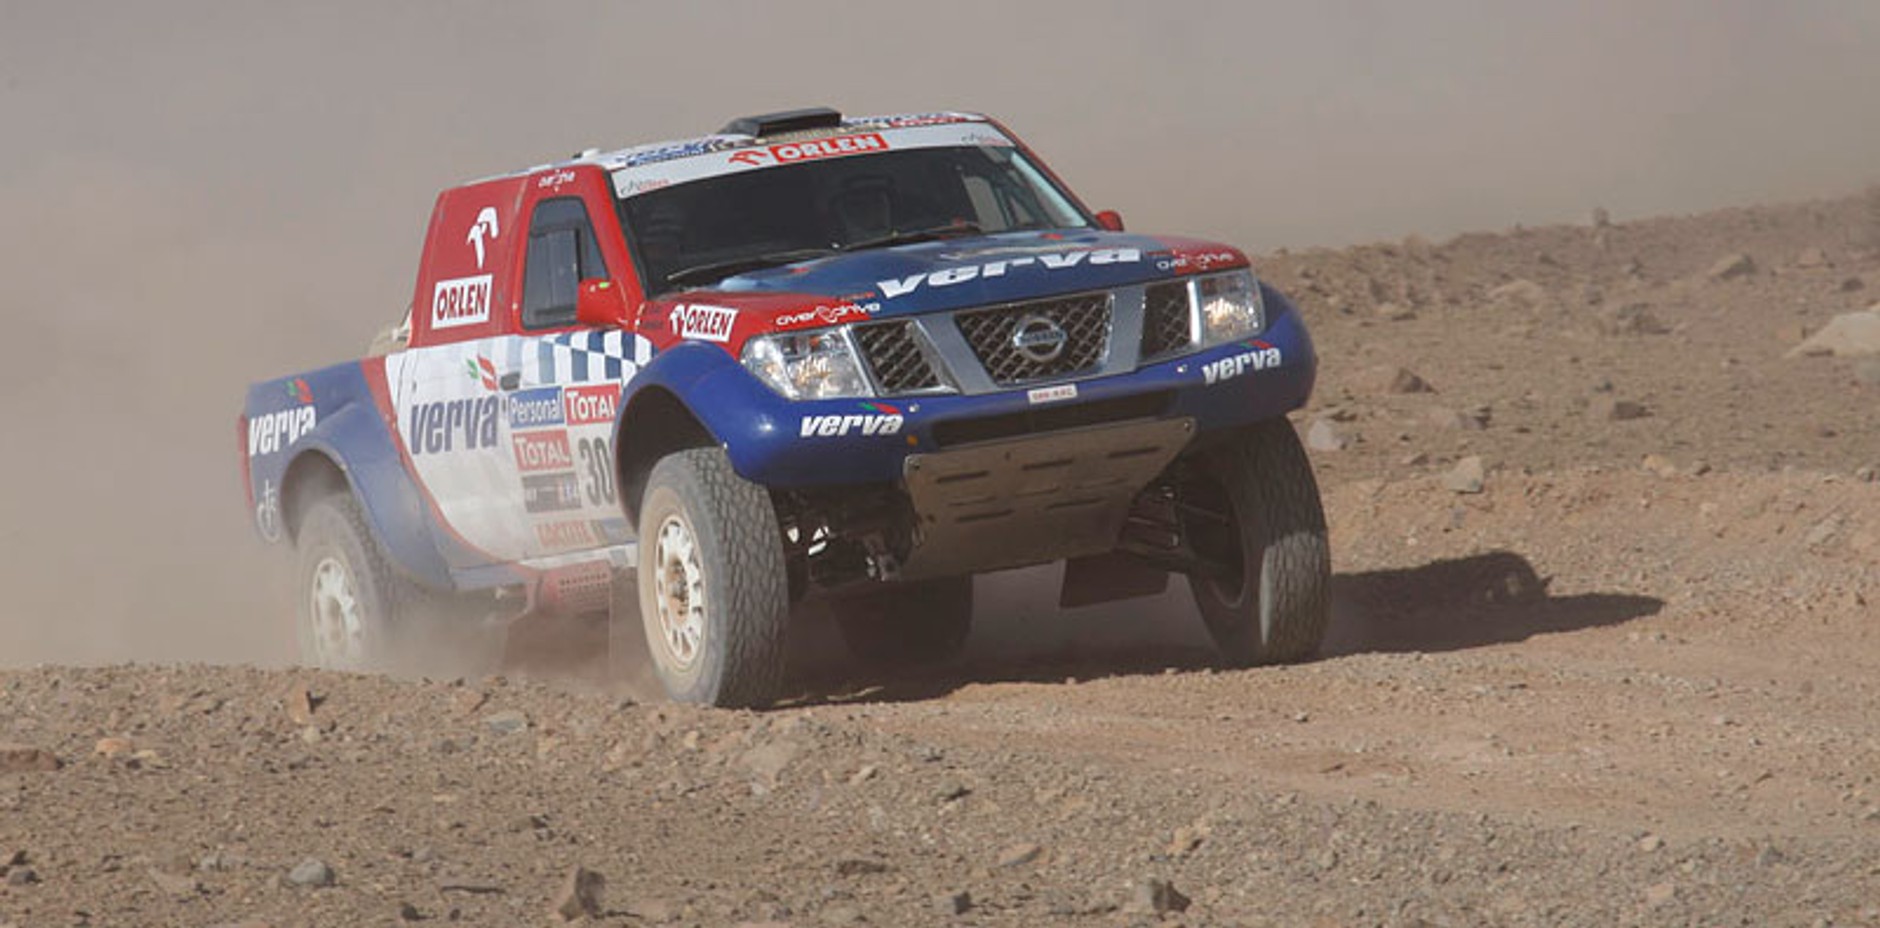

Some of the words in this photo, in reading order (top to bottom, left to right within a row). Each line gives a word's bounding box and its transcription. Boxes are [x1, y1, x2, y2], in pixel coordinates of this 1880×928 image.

[781, 135, 880, 160] ORLEN
[877, 249, 1140, 298] verva
[437, 283, 487, 321] ORLEN
[687, 304, 731, 337] ORLEN
[1202, 348, 1281, 385] verva
[411, 395, 500, 455] verva
[510, 391, 562, 424] Personal
[801, 414, 904, 438] verva
[249, 405, 316, 456] verva
[515, 436, 570, 468] TOTAL
[578, 437, 616, 506] 30
